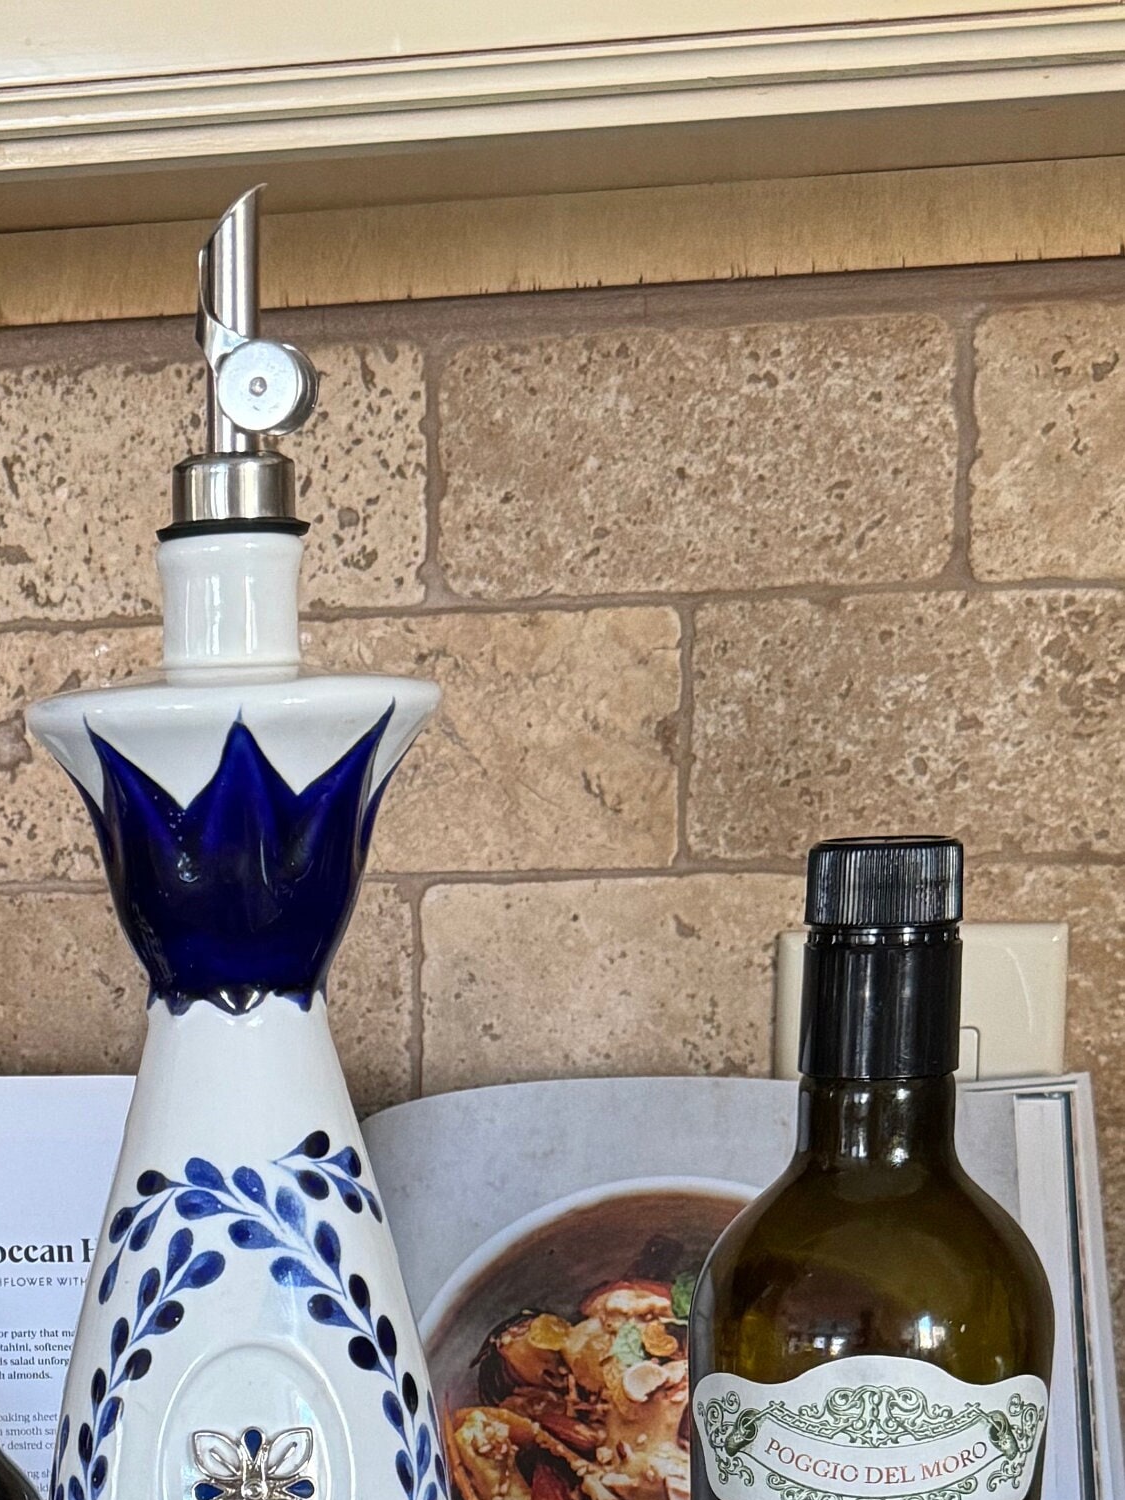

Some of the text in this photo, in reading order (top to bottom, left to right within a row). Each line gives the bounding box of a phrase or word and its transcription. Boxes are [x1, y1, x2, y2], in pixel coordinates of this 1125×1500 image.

[11, 1329, 37, 1340] party
[40, 1327, 59, 1338] that
[10, 1356, 35, 1366] salad
[8, 1370, 53, 1380] almonds.
[32, 1411, 58, 1422] sheet
[5, 1426, 43, 1436] smooth
[7, 1440, 43, 1450] desired
[763, 1437, 988, 1485] POGGIO DEL MORO
